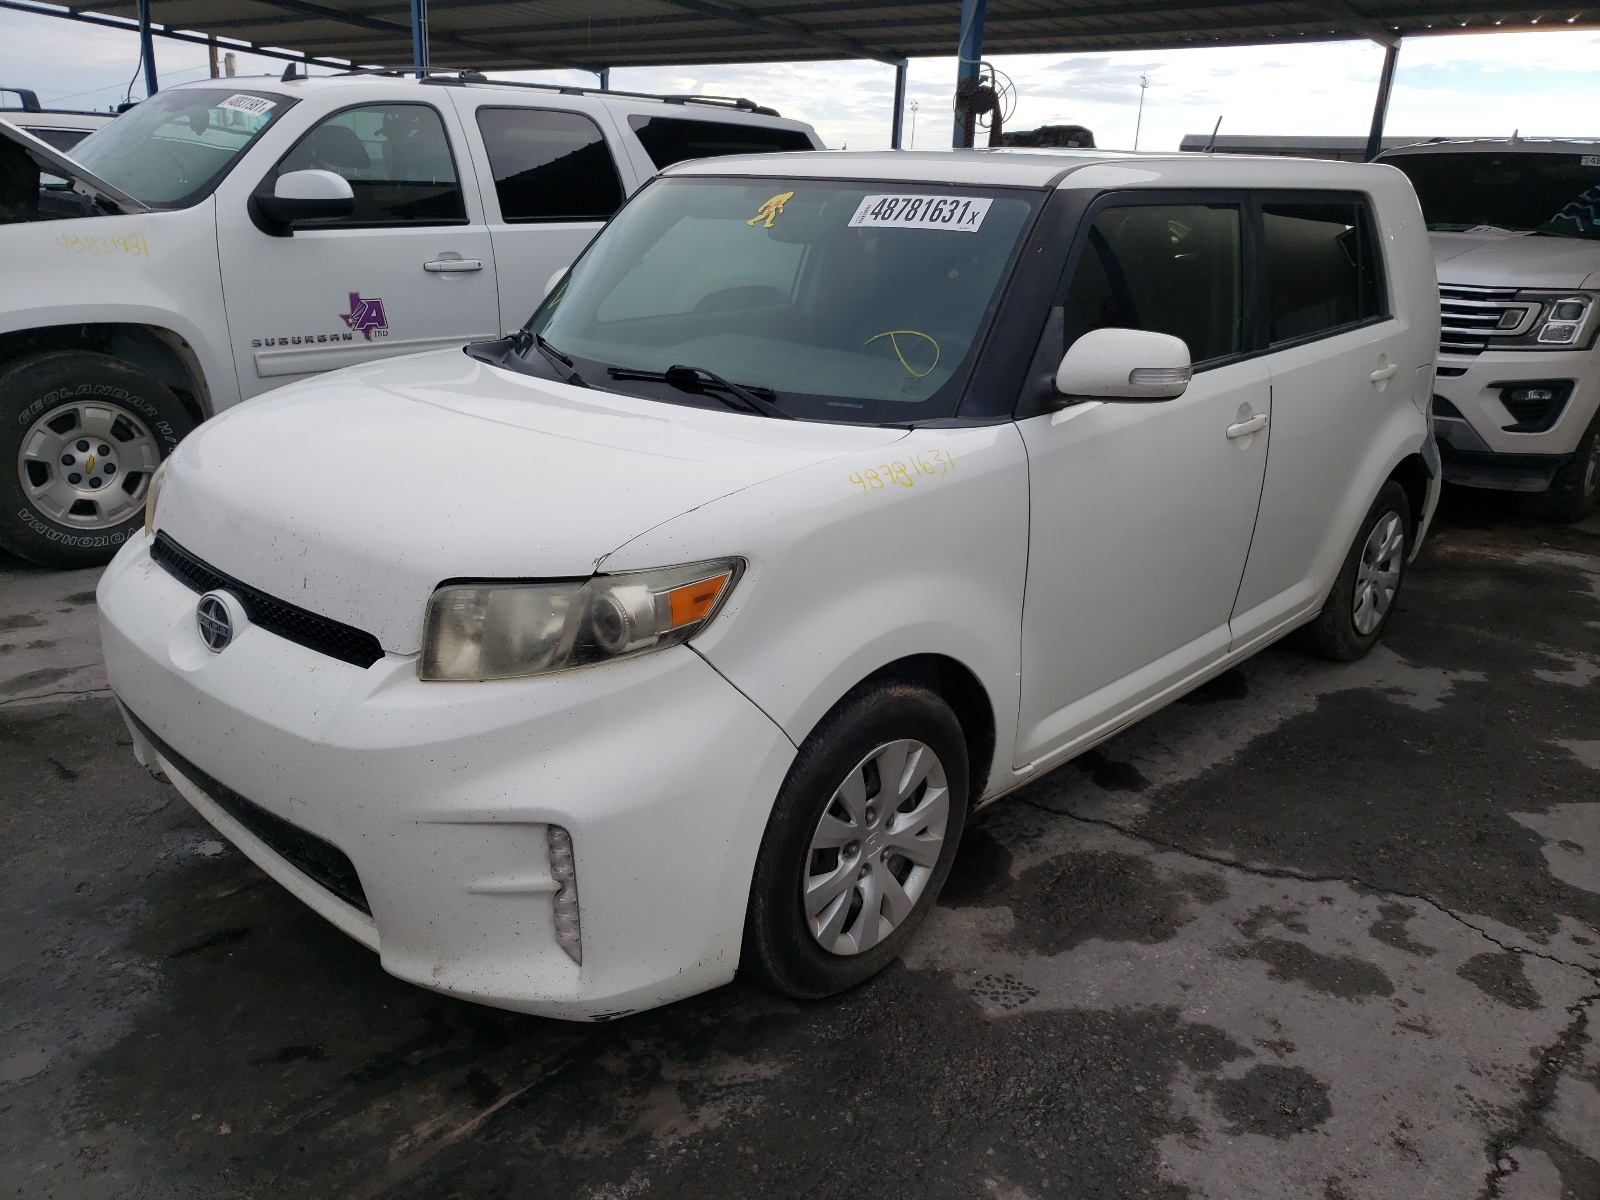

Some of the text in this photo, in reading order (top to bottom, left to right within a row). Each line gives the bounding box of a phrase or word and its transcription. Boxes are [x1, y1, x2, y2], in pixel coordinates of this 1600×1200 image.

[251, 332, 353, 348] SUBURBAN
[374, 330, 388, 338] ISD
[18, 384, 158, 425] GEOLANDAR
[848, 449, 956, 496] 48781631
